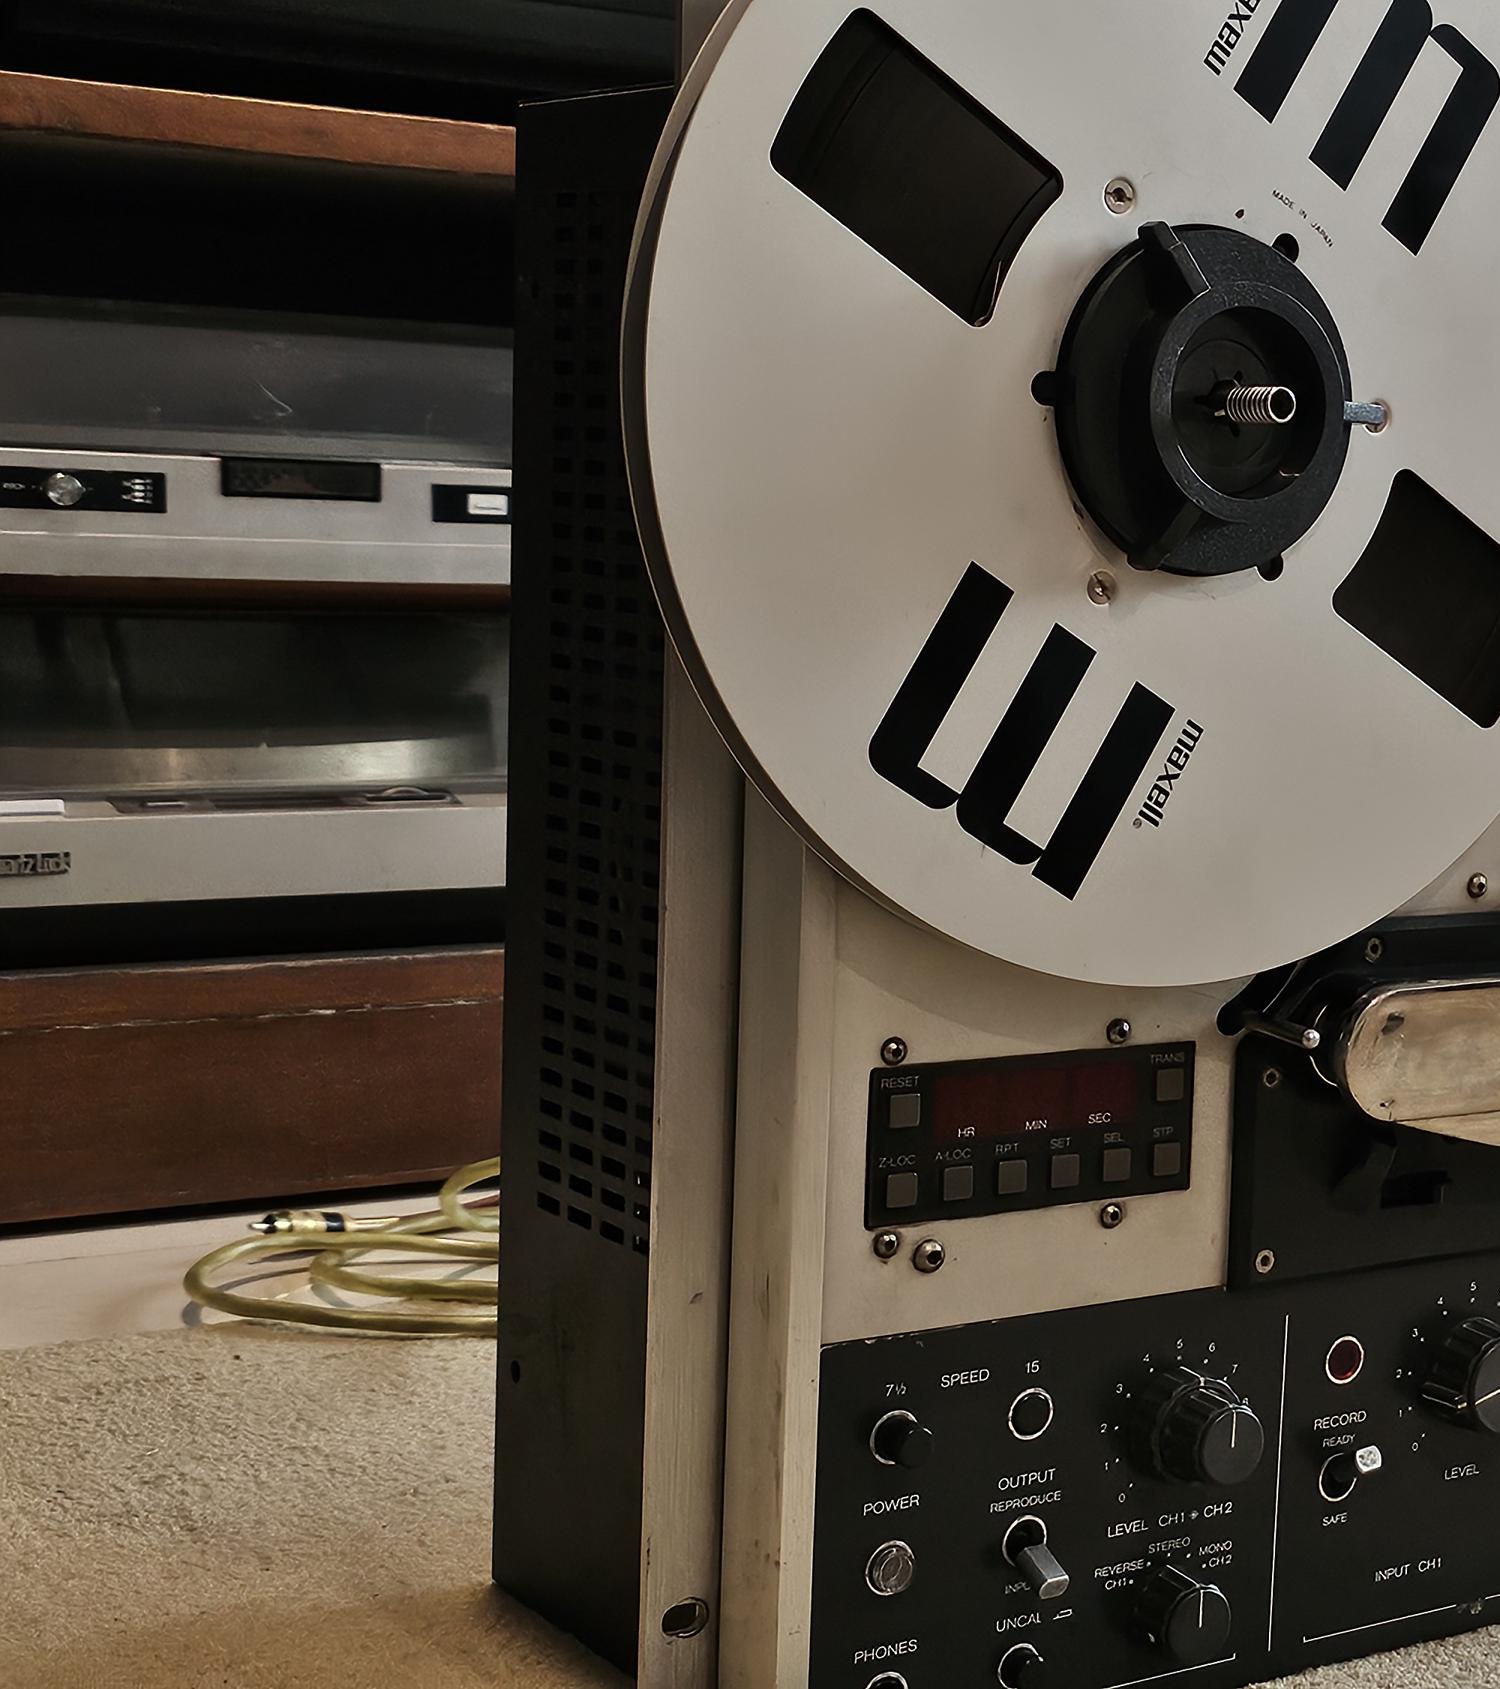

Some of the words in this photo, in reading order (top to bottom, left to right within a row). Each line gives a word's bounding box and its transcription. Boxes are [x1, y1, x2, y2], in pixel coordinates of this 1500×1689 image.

[1272, 190, 1294, 210] MADE
[1311, 223, 1333, 247] JAPAN
[1137, 718, 1205, 828] maxell
[1150, 1052, 1184, 1064] TRANS
[880, 1075, 919, 1089] RESET
[1025, 1119, 1048, 1131] MIN
[1087, 1112, 1112, 1124] SEC
[957, 1126, 976, 1138] HR
[1103, 1132, 1124, 1144] SEL
[1152, 1126, 1174, 1138] STP
[995, 1142, 1020, 1154] RPT
[1050, 1136, 1072, 1149] SET
[878, 1154, 917, 1168] Z-LOC
[935, 1148, 972, 1161] A-LOC
[1470, 1281, 1477, 1291] 5
[1411, 1328, 1419, 1338] 3
[1208, 1341, 1216, 1352] 6
[1024, 1359, 1040, 1374] 15
[940, 1368, 990, 1388] SPEED
[1115, 1383, 1123, 1394] 3
[1313, 1410, 1367, 1430] RECORD
[1100, 1423, 1108, 1433] 2
[1322, 1434, 1356, 1448] READY
[1411, 1441, 1419, 1452] 0
[1444, 1463, 1480, 1480] LEVEL
[998, 1468, 1056, 1491] OUTPUT
[990, 1490, 1062, 1513] REPRODUCE
[1118, 1492, 1126, 1503] 0
[863, 1494, 920, 1516] POWER
[1107, 1519, 1149, 1538] LEVEL
[1158, 1511, 1185, 1527] CH1
[1203, 1501, 1233, 1518] CH2
[1322, 1512, 1348, 1527] SAFE
[1148, 1536, 1191, 1554] STEREO
[1199, 1540, 1233, 1556] MONO
[1094, 1558, 1145, 1578] REVERSE
[1208, 1554, 1232, 1568] CH2
[1374, 1563, 1410, 1582] INPUT
[1418, 1557, 1442, 1573] CH1
[1105, 1578, 1127, 1590] CH1
[996, 1612, 1042, 1633] UNCAL
[853, 1639, 918, 1664] PHONES
